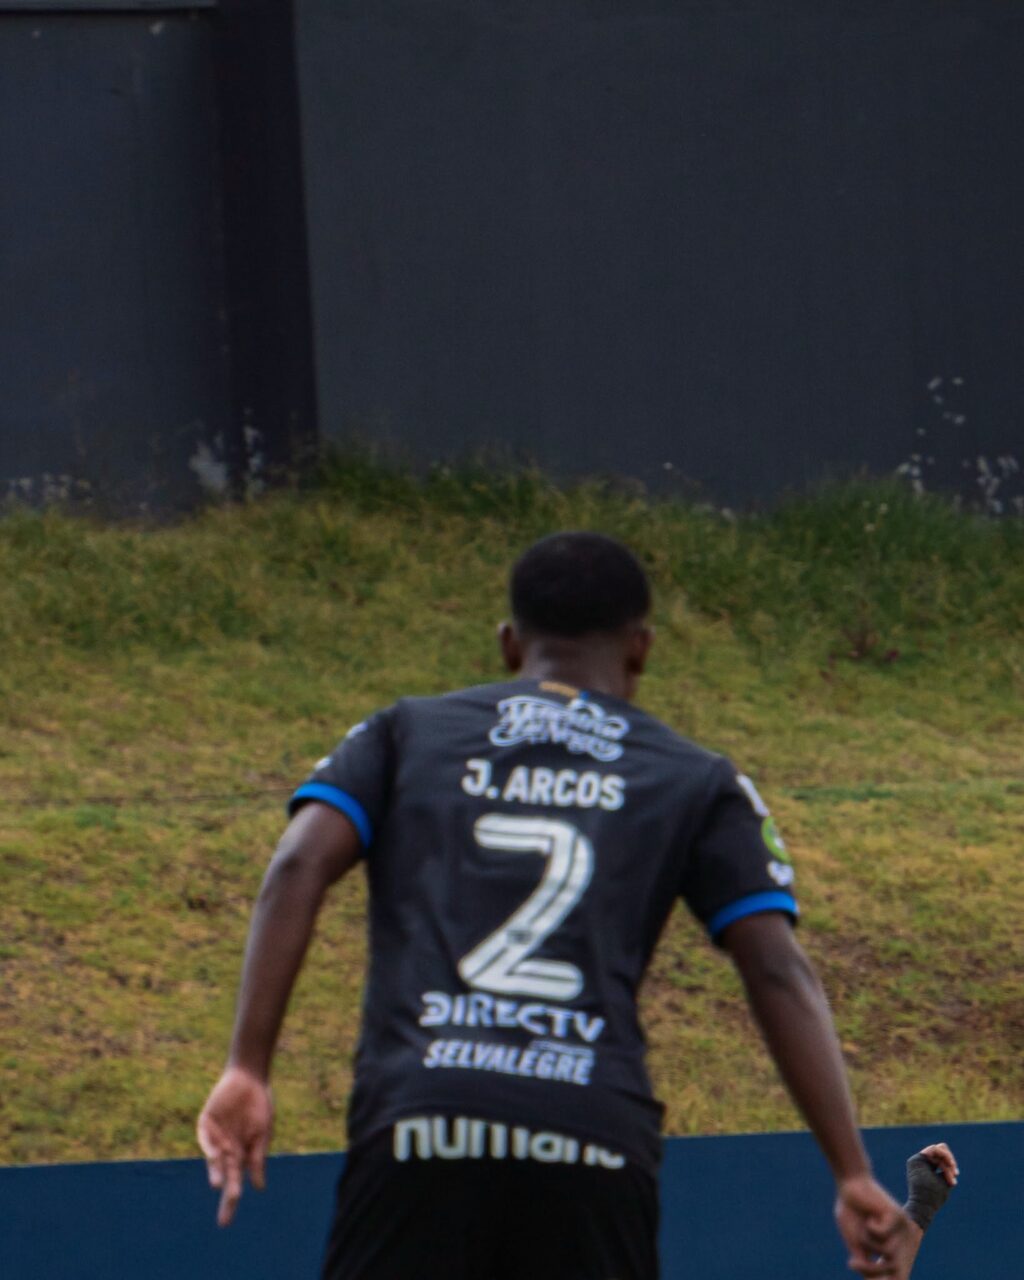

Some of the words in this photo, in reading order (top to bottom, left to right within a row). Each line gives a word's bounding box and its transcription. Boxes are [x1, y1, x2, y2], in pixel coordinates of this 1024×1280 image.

[461, 758, 499, 799] J.
[502, 764, 627, 811] ARCOS
[458, 812, 594, 1001] 2
[419, 990, 605, 1042] DIRECTV
[422, 1039, 594, 1086] SELVALEGRE
